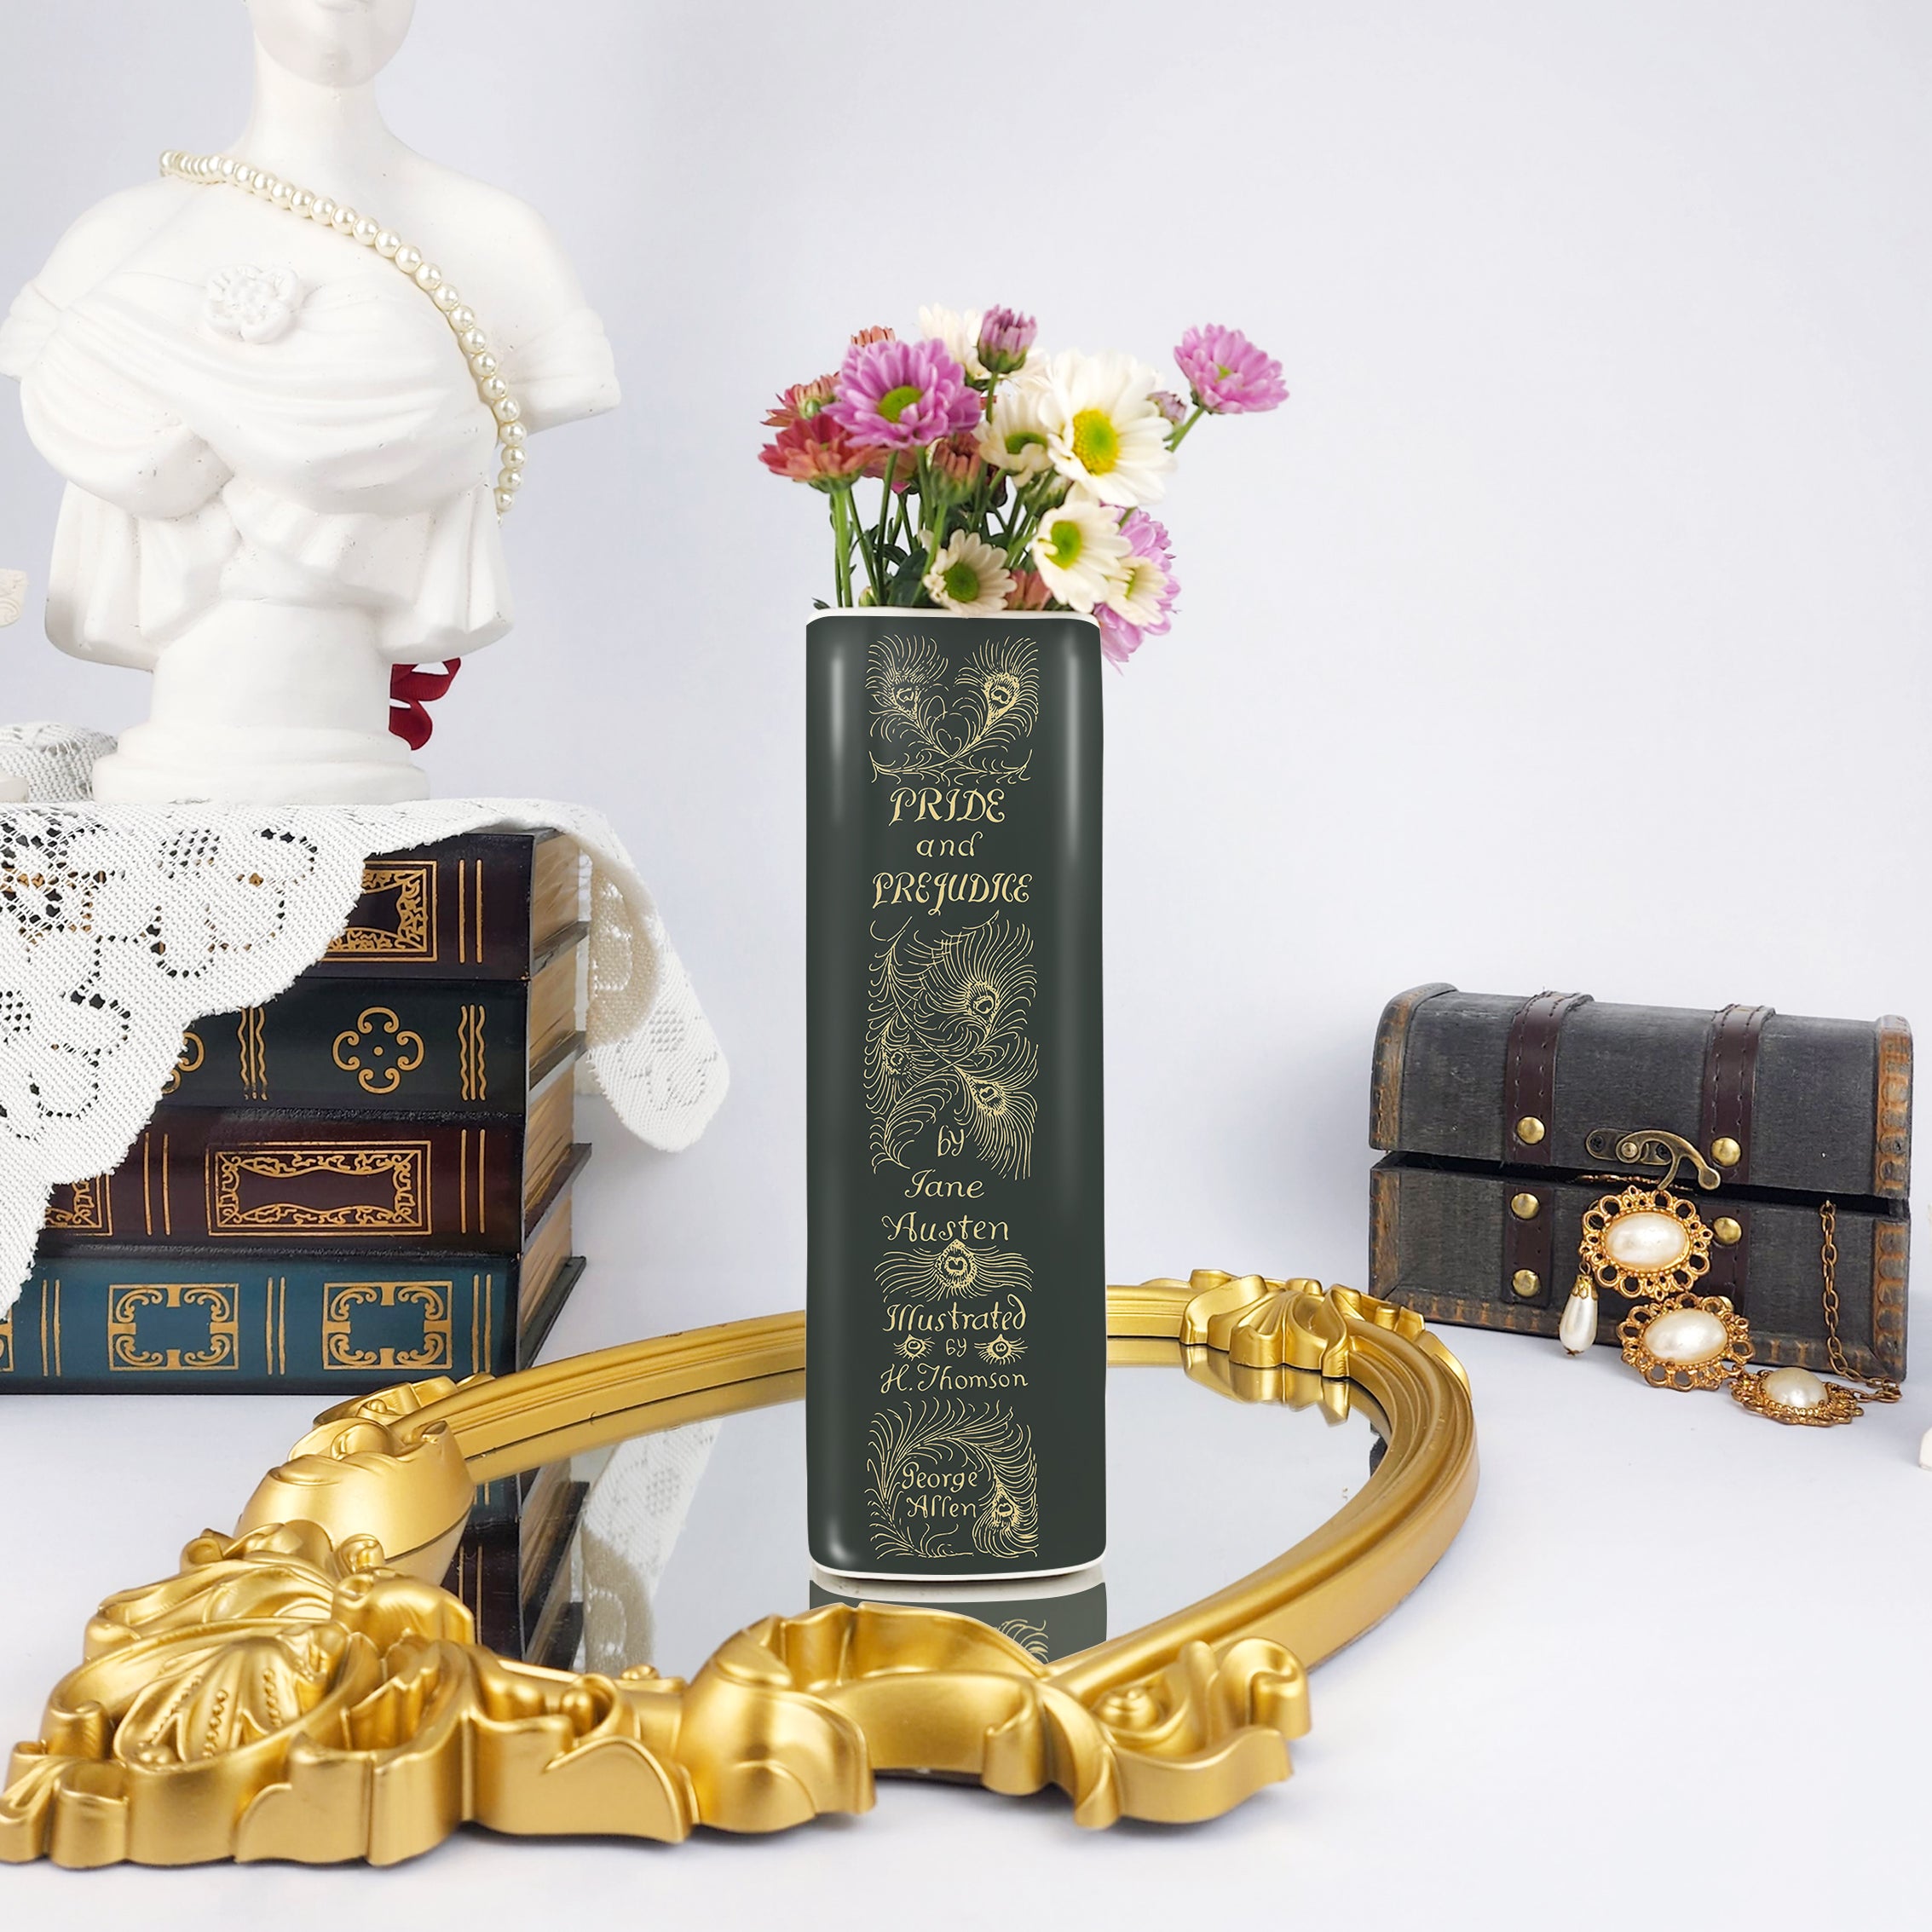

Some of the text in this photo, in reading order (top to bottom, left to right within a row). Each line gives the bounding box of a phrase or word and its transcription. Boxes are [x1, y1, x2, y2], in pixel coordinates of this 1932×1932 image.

[889, 787, 1006, 827] PRIDE
[916, 831, 983, 857] and
[872, 872, 1033, 916] PREJUDICE
[937, 1125, 965, 1157] by
[904, 1168, 985, 1199] Jane
[881, 1211, 1009, 1242] Austen
[882, 1294, 1027, 1331] Illustrated
[917, 1363, 1029, 1392] Thomson
[902, 1462, 978, 1493] George
[906, 1495, 977, 1518] Allen
